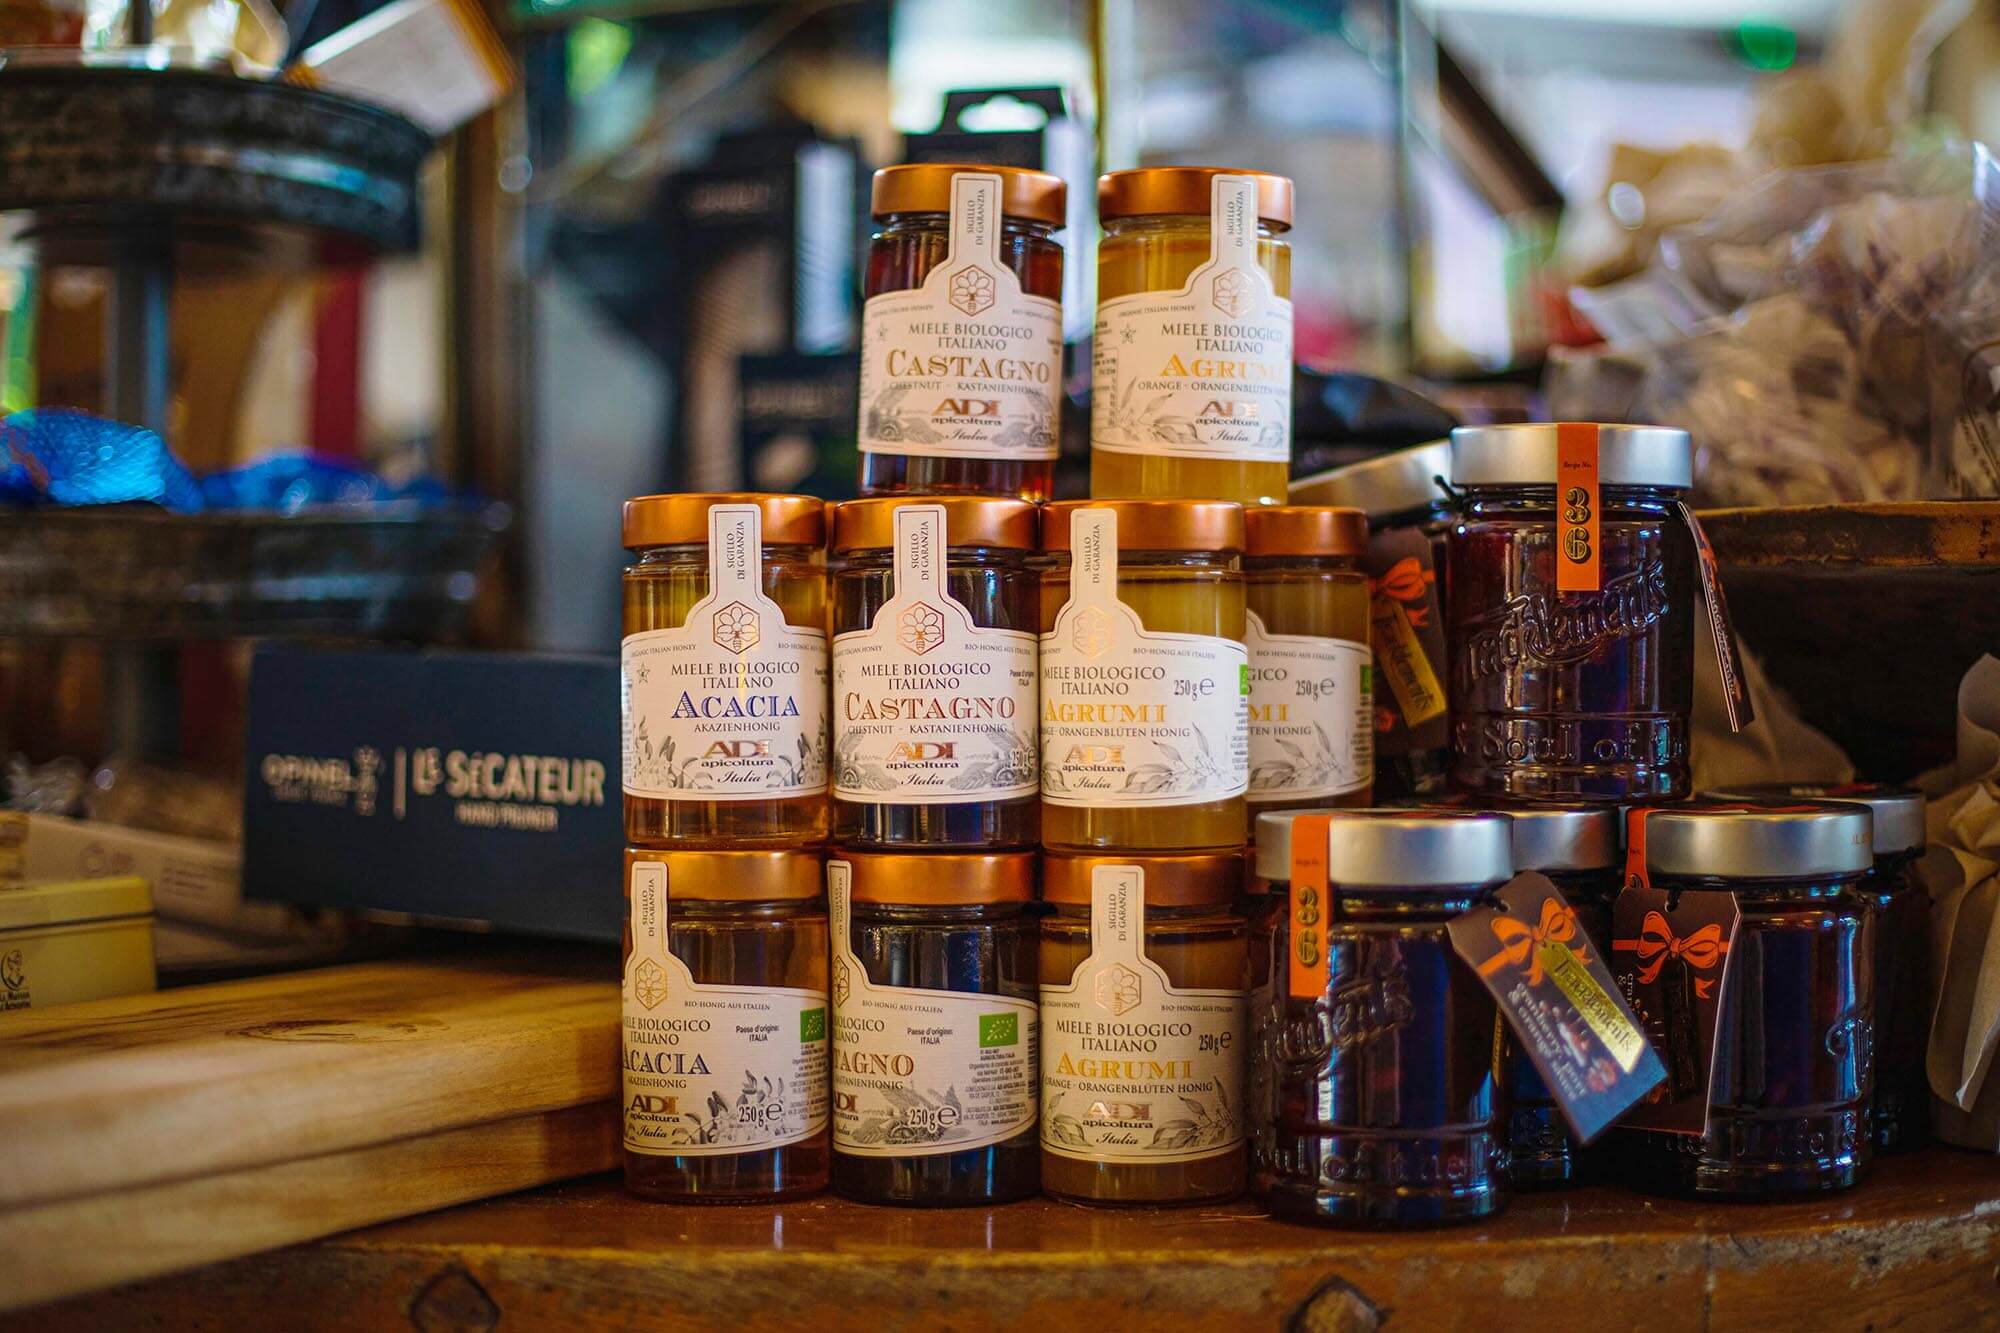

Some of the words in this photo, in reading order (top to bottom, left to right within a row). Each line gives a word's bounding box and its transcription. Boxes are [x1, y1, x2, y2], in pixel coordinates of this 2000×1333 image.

[909, 323, 949, 335] MIELE
[955, 324, 1033, 340] BIOLOGICO
[1161, 323, 1209, 336] MIELE
[938, 337, 1006, 351] ITALIANO
[1196, 338, 1263, 354] ITALIANO
[887, 348, 1050, 384] CASTAGNO
[1138, 381, 1182, 391] ORANGE
[931, 398, 1001, 416] ADI
[931, 417, 1002, 427] apicoltura
[1195, 418, 1260, 427] apicoltura
[946, 428, 988, 441] Italia
[1210, 429, 1249, 442] Italia
[727, 533, 735, 568] SIGILLO
[737, 521, 745, 567] GARANZIA
[911, 533, 919, 569] SIGILLO
[737, 569, 745, 580] DI
[921, 570, 929, 580] DI
[1093, 574, 1100, 583] DI
[671, 663, 714, 676] MIELE
[719, 662, 800, 674] BIOLOGICO
[861, 663, 899, 676] MIELE
[904, 663, 991, 675] BIOLOGICO
[1043, 666, 1070, 679] MIELE
[1074, 667, 1166, 681] BIOLOGICO
[703, 677, 773, 689] ITALIANO
[889, 678, 960, 690] ITALIANO
[1061, 682, 1129, 695] ITALIANO
[671, 691, 800, 719] ACACIA
[845, 691, 1015, 721] CASTAGNO
[1044, 698, 1167, 723] AGRUMI
[694, 722, 781, 733] AKAZIENHONIG
[847, 725, 894, 735] CHESTNUT
[909, 724, 1007, 734] KASTANIENHONIG
[1150, 728, 1190, 737] HONIG
[1274, 726, 1312, 736] HONIG
[702, 739, 772, 759] ADI
[886, 742, 958, 760] ADI
[1064, 744, 1124, 763] ADI
[701, 758, 774, 769] apicoltura
[886, 760, 959, 770] apicoltura
[1062, 764, 1126, 773] apicoltura
[718, 770, 761, 783] Italia
[901, 773, 944, 785] Italia
[1073, 776, 1111, 789] Italia
[1108, 894, 1116, 929] SIGILLO
[1118, 882, 1127, 929] GARANZIA
[1118, 931, 1126, 941] DI
[727, 1002, 742, 1010] AUS
[744, 1003, 771, 1011] ITALIEN
[899, 1003, 913, 1011] AUS
[914, 1004, 943, 1014] ITALIEN
[638, 1018, 711, 1032] BIOLOGICO
[736, 1025, 753, 1034] Paese
[907, 1027, 925, 1036] Paese
[1056, 1020, 1092, 1034] MIELE
[1097, 1023, 1192, 1037] BIOLOGICO
[630, 1031, 679, 1045] ITALIANO
[749, 1034, 768, 1042] ITALIA
[920, 1037, 940, 1045] ITALIA
[1081, 1038, 1157, 1052] ITALIANO
[834, 1047, 914, 1076] TAGNO
[1056, 1052, 1193, 1080] AGRUMI
[1178, 1082, 1213, 1092] HONIG
[631, 1094, 679, 1115] ADI
[631, 1114, 680, 1122] apicoltura
[1083, 1102, 1153, 1121] ADI
[1083, 1119, 1153, 1129] apicoltura
[637, 1124, 667, 1138] Italia
[1096, 1132, 1138, 1145] Italia
